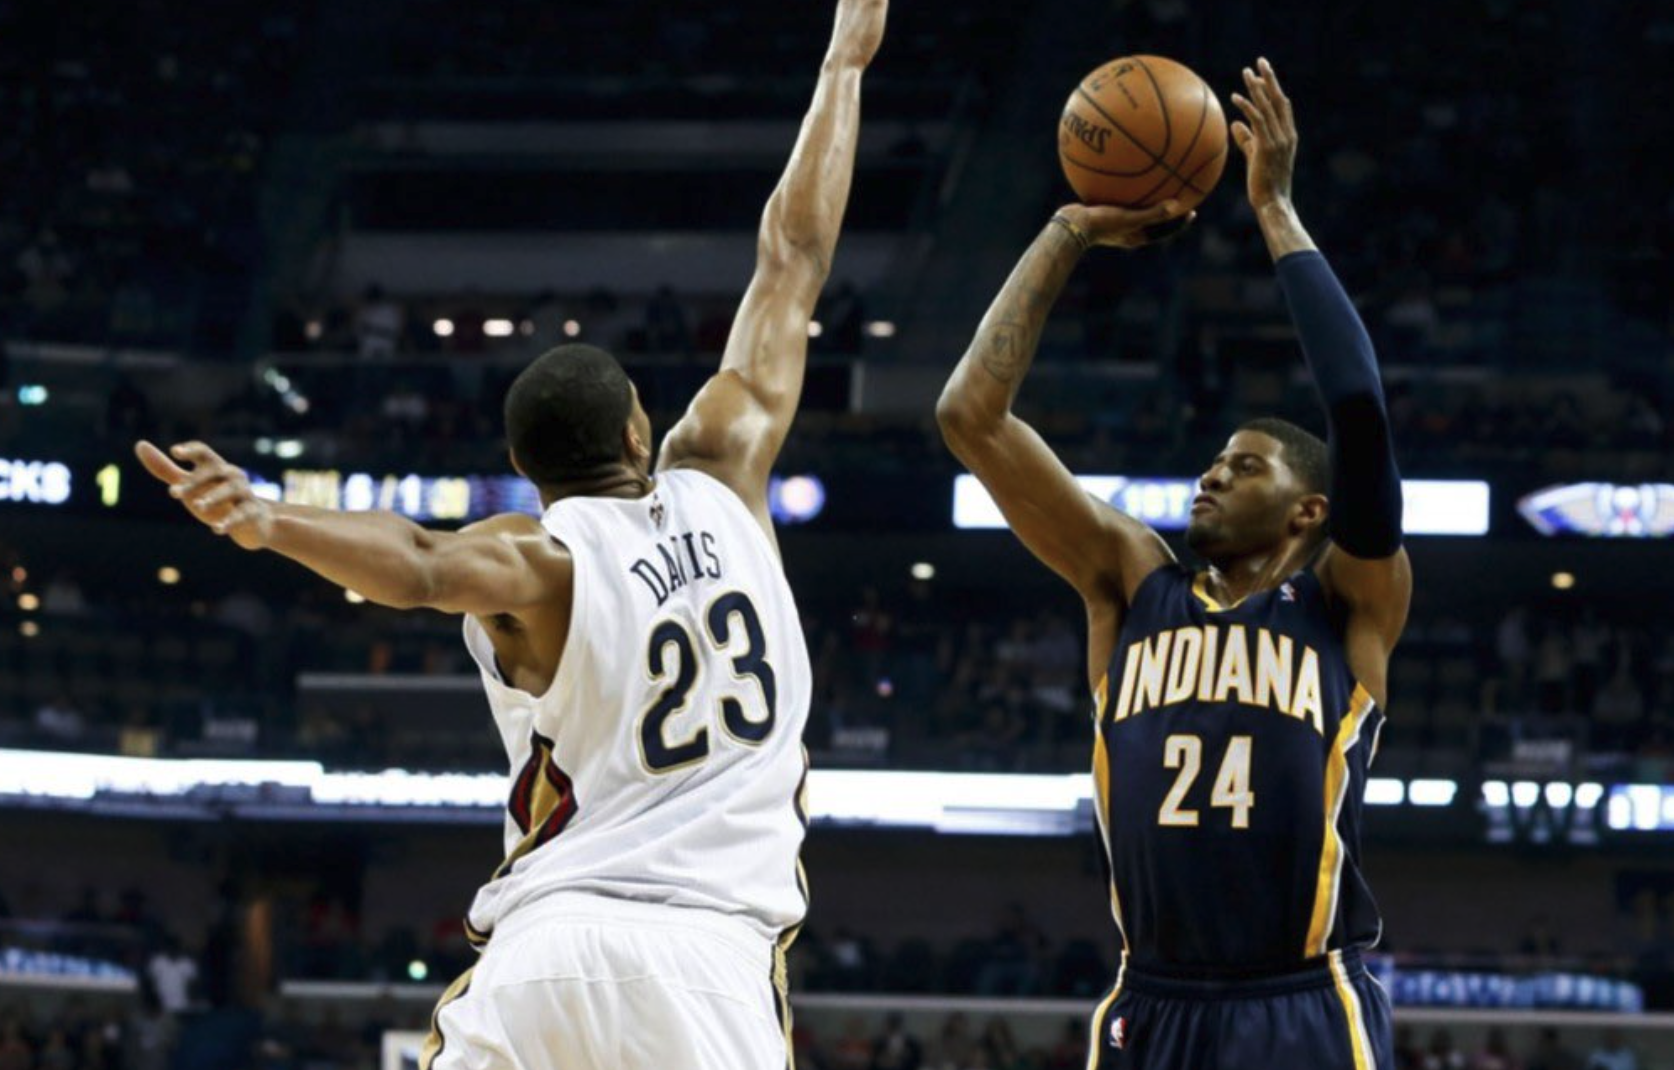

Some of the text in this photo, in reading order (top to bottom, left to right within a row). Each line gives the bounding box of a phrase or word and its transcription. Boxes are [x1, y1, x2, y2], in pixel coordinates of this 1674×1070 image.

[95, 464, 121, 507] 1
[636, 588, 777, 775] 23
[1114, 624, 1325, 739] INDIANA
[1157, 734, 1255, 829] 24
